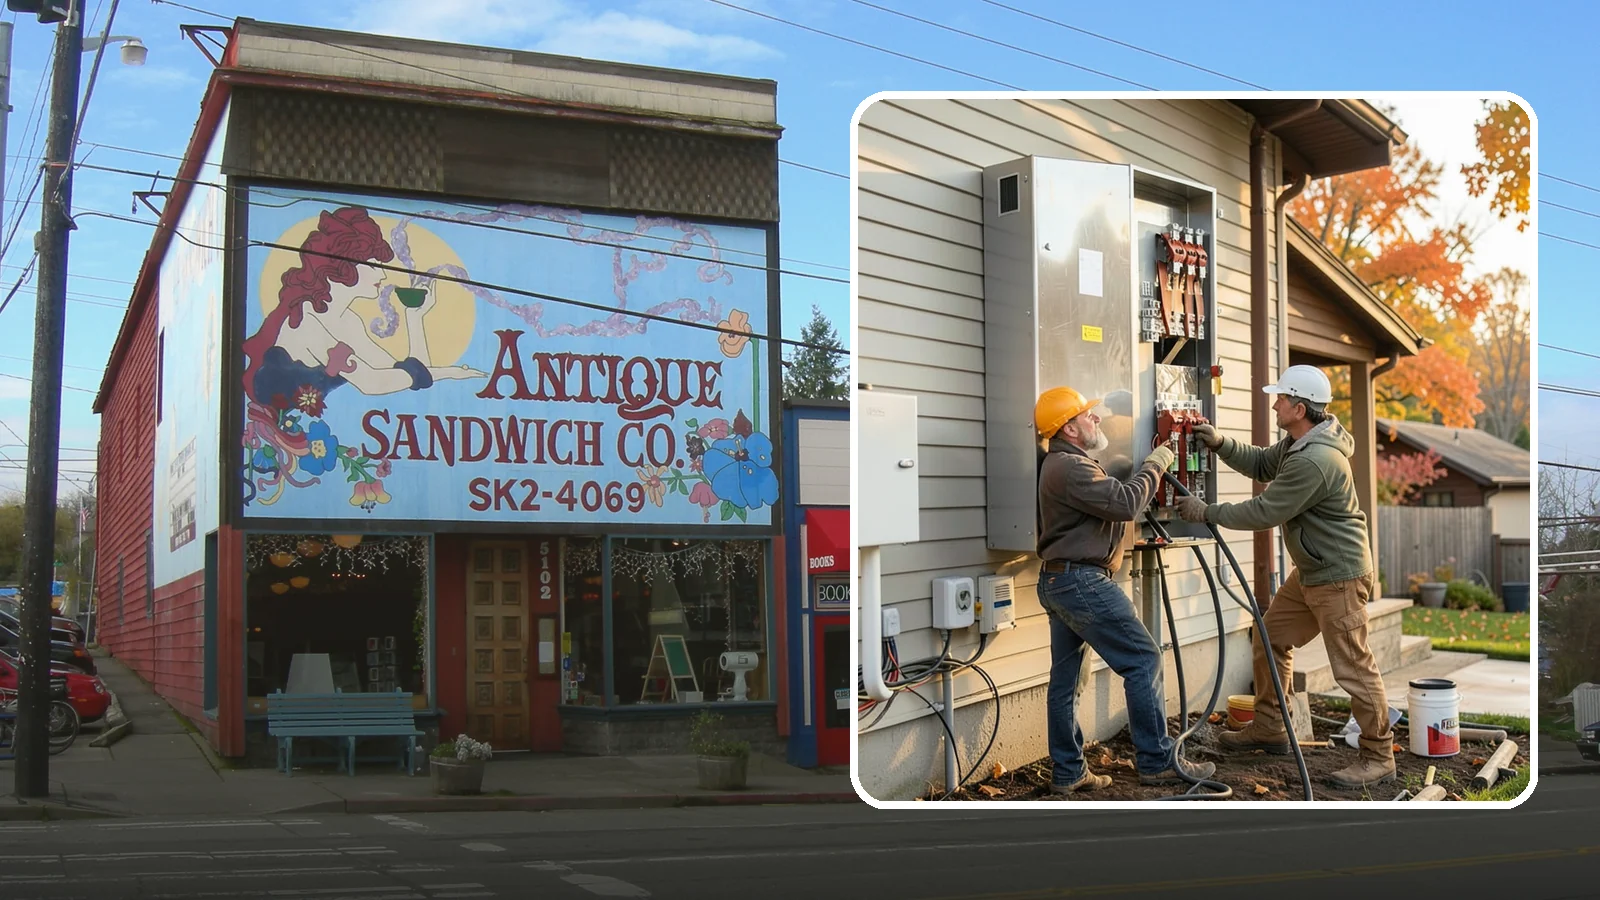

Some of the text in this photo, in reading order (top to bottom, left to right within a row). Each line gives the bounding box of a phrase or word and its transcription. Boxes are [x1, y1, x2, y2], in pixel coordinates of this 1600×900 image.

[475, 329, 723, 420] ANTIQUE
[361, 409, 686, 469] SANDWICH CO.
[468, 477, 646, 512] SK2-4069
[540, 541, 552, 599] 5102
[809, 555, 835, 569] BOOKS
